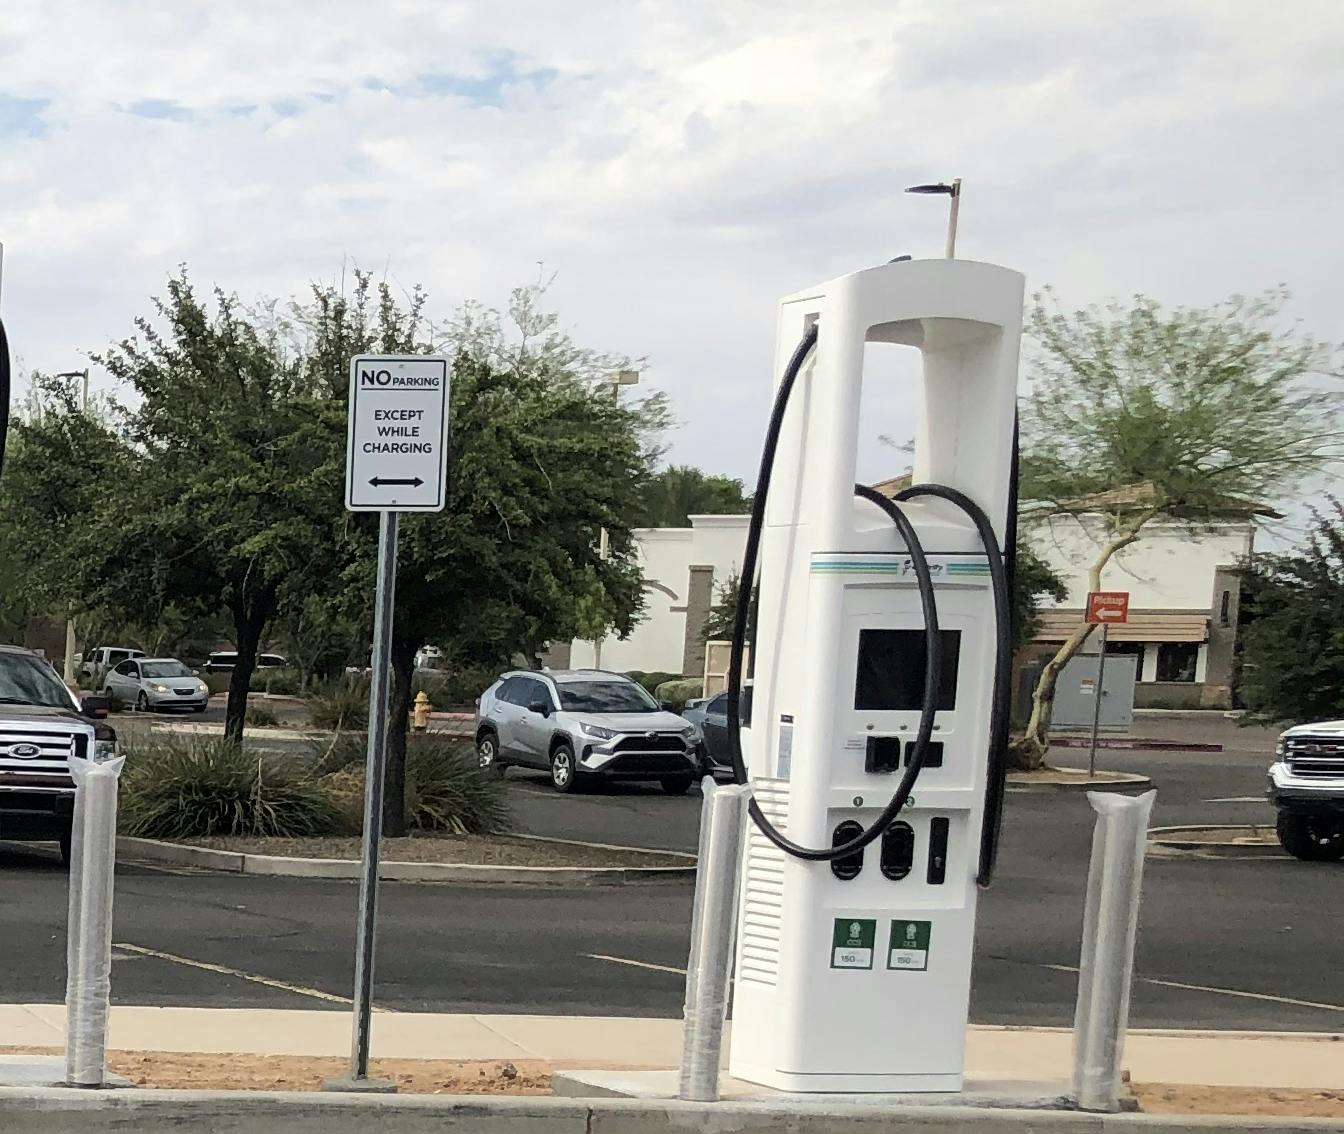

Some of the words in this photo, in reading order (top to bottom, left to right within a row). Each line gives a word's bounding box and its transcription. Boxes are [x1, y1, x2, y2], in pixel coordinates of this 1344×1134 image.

[361, 370, 392, 386] NO
[392, 377, 440, 387] PARKING
[374, 409, 424, 421] EXCEPT
[377, 426, 420, 437] WHILE
[362, 443, 433, 454] CHARGING
